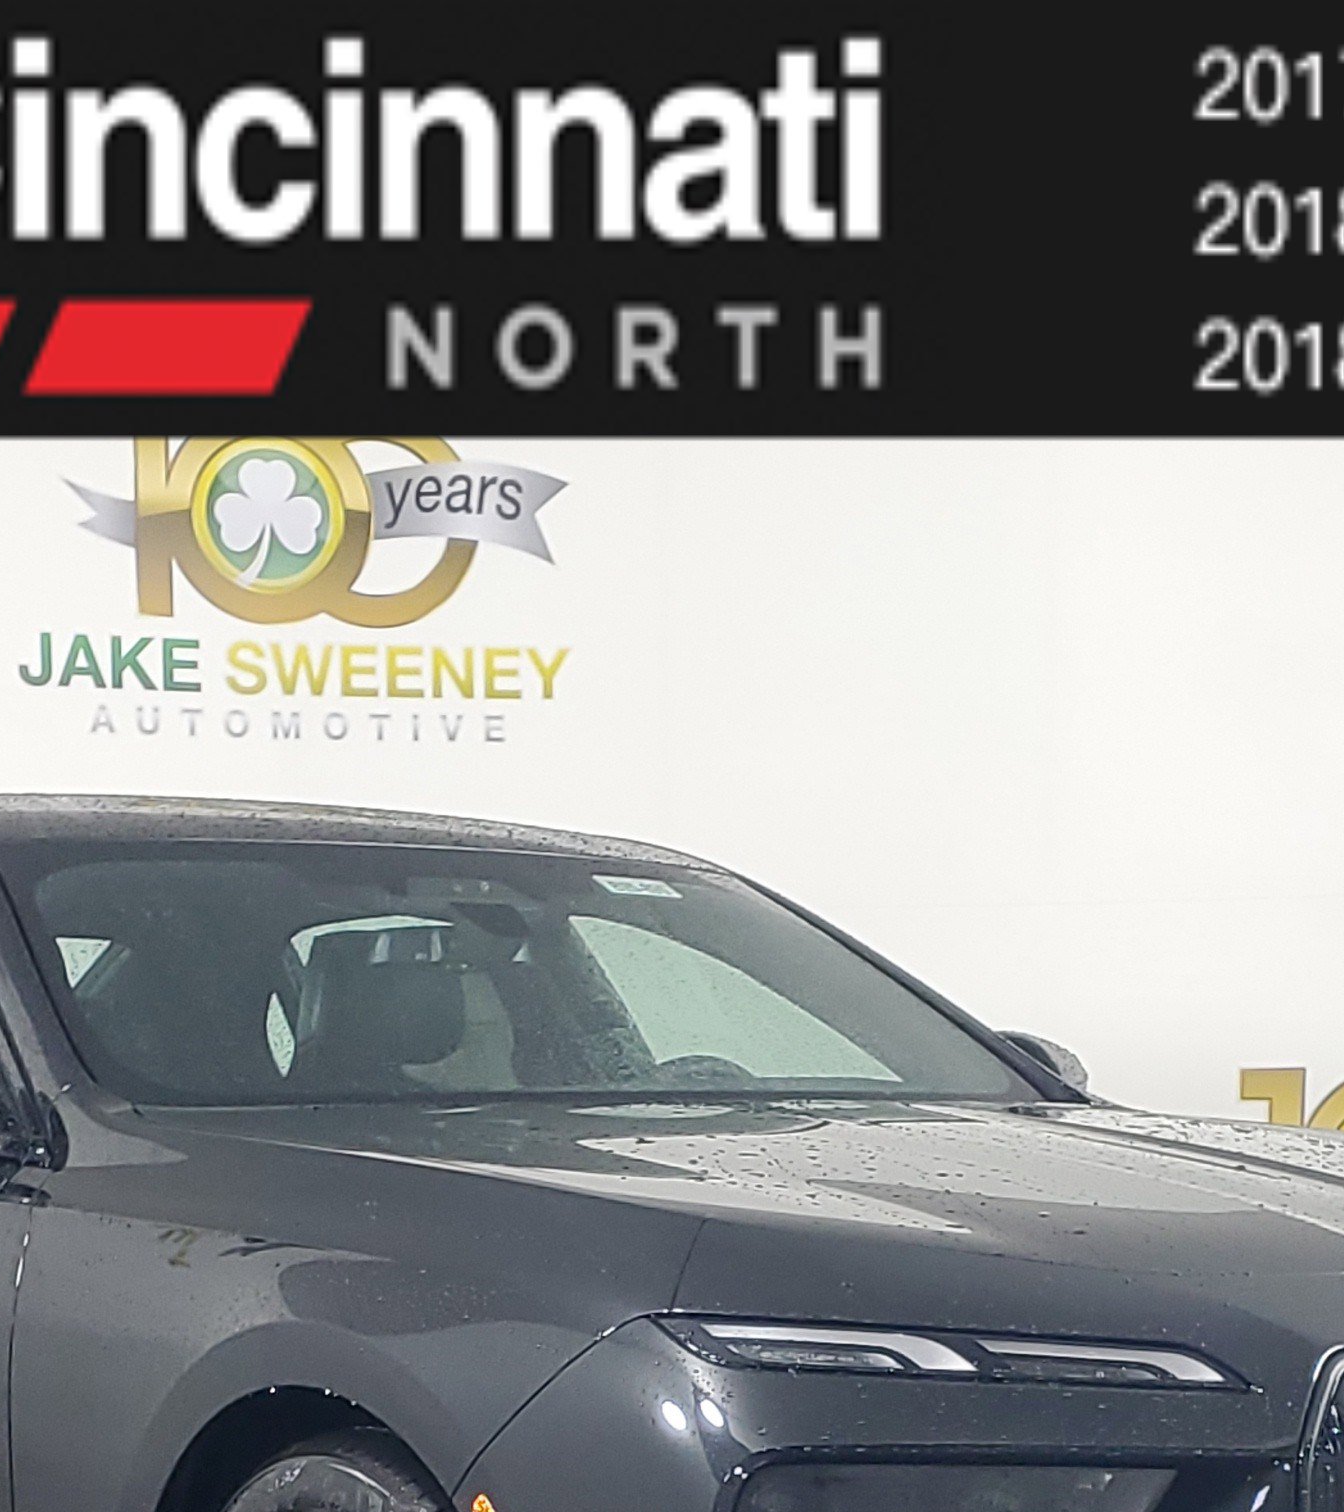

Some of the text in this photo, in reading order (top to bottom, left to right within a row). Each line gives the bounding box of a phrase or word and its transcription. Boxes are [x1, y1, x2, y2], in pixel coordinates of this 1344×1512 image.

[382, 473, 524, 530] years
[18, 631, 572, 700] JAKE SWEENEY
[90, 704, 508, 744] AUTOMOTIVE
